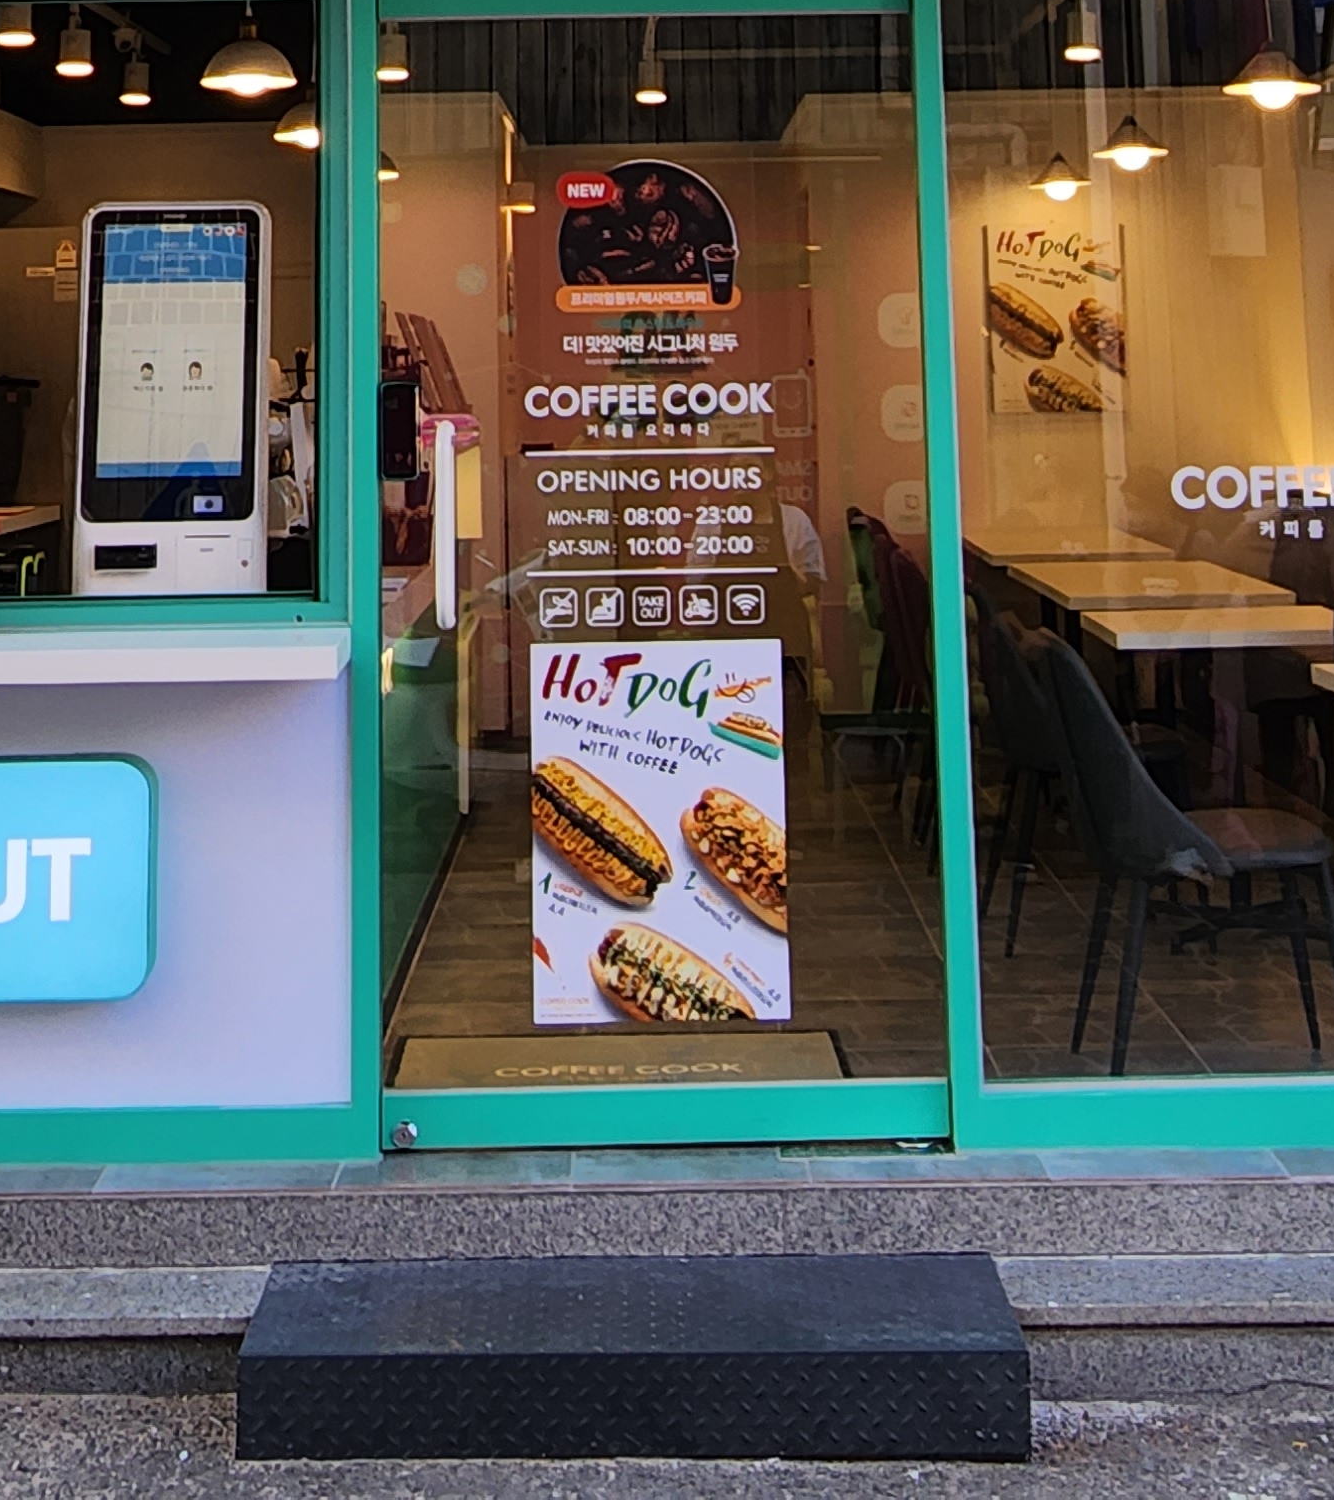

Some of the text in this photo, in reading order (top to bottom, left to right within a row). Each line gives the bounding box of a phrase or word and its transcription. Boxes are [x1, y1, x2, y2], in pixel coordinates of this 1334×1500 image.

[566, 183, 605, 198] NEW
[586, 335, 645, 354] 맛있어진
[647, 333, 706, 353] 시그니처
[708, 333, 739, 352] 원두
[524, 382, 774, 417] COFFEE COOK
[645, 423, 711, 438] 요리하다
[536, 469, 661, 493] OPENING
[669, 467, 762, 491] HOURS
[1259, 519, 1325, 539] 커피를
[637, 595, 665, 609] TAKE
[640, 609, 664, 620] OUT
[544, 710, 583, 730] ENJOY
[579, 739, 679, 775] WITH COFFEE
[495, 1064, 625, 1078] COFFEE
[635, 1062, 744, 1076] COOK
